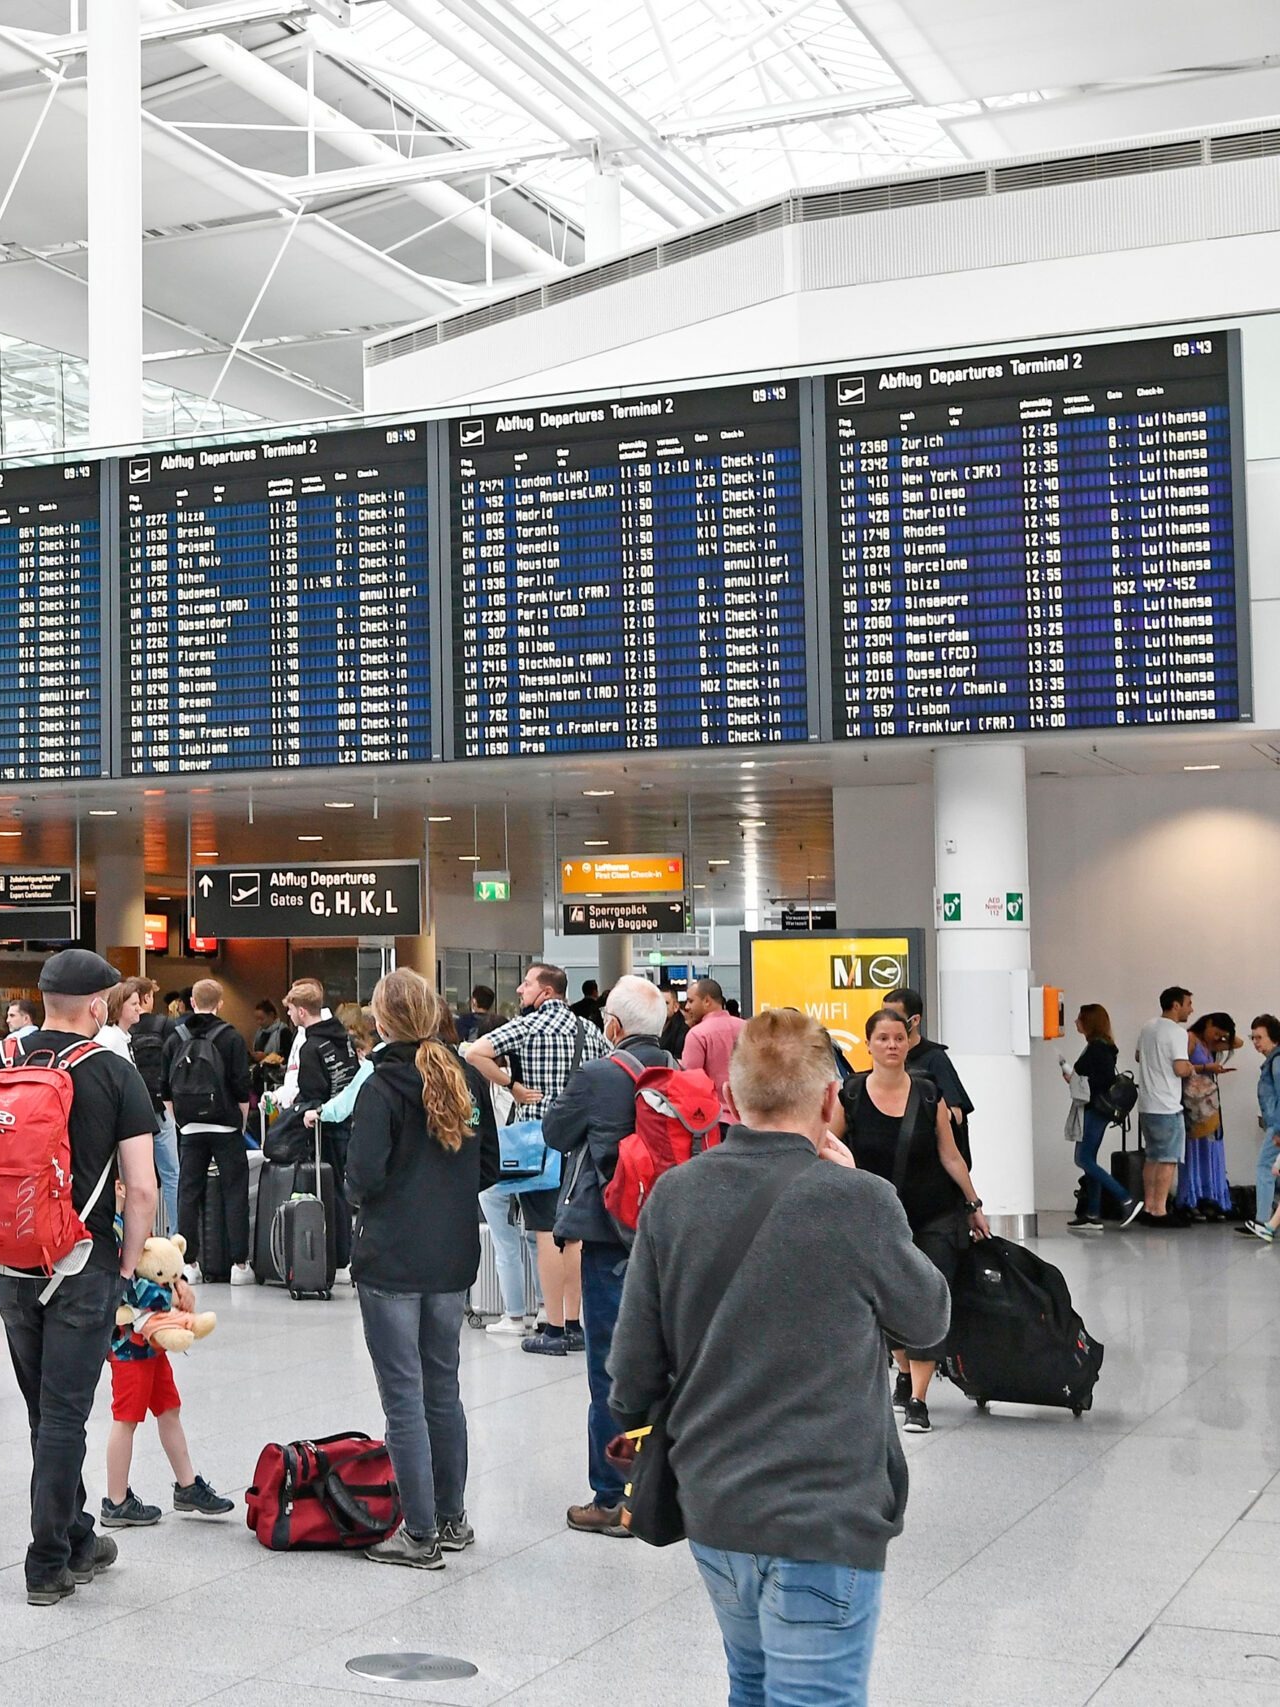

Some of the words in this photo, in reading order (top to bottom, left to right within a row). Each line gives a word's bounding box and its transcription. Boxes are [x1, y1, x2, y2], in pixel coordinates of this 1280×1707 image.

[1173, 340, 1212, 357] 09:43
[879, 372, 922, 390] Abflug
[930, 365, 1003, 386] Departures
[1010, 354, 1068, 375] Terminal
[1073, 353, 1082, 369] 2
[496, 415, 534, 432] Abflug
[540, 410, 604, 429] Departures
[610, 399, 661, 419] Terminal
[665, 398, 673, 413] 2
[161, 454, 194, 470] Abflug
[200, 449, 256, 467] Departures
[261, 440, 306, 458] Terminal
[309, 439, 317, 453] 2
[840, 478, 854, 491] LH
[867, 475, 888, 488] 410
[902, 473, 923, 485] New
[930, 469, 958, 483] York
[1023, 459, 1058, 475] 12:35
[1139, 448, 1207, 464] Lufthansa
[462, 498, 474, 510] LH
[485, 495, 504, 508] 452
[621, 480, 651, 495] 11:50
[696, 474, 716, 488] L26
[722, 469, 774, 485] Check-in
[39, 553, 80, 567] Check-in
[871, 598, 891, 612] 327
[905, 595, 968, 609] Singapore
[1027, 586, 1062, 601] 13:10
[1143, 576, 1196, 592] 447-452
[490, 692, 507, 705] 107
[519, 689, 580, 703] Washington
[625, 683, 656, 697] 12:20
[727, 676, 780, 691] Check-in
[846, 723, 860, 736] LH
[875, 722, 895, 735] 109
[908, 718, 970, 733] Frankfurt
[1030, 713, 1065, 728] 14:00
[1147, 708, 1216, 722] Lufthansa
[132, 762, 143, 773] LH
[179, 759, 212, 771] Denver
[272, 754, 300, 766] 11:50
[339, 751, 356, 763] L23
[361, 748, 408, 762] Check-in
[270, 872, 307, 888] Abflug
[311, 871, 376, 888] Departures
[594, 872, 610, 880] First
[611, 871, 630, 879] Class
[630, 870, 662, 879] Check-in
[270, 893, 303, 906] Gates
[310, 892, 331, 917] G,
[336, 891, 356, 916] H,
[361, 891, 381, 916] K,
[386, 890, 398, 913] L
[589, 904, 647, 917] Sperrgepäck
[589, 918, 615, 930] Bulky
[618, 918, 658, 930] Baggage
[804, 1002, 847, 1020] WIFI
